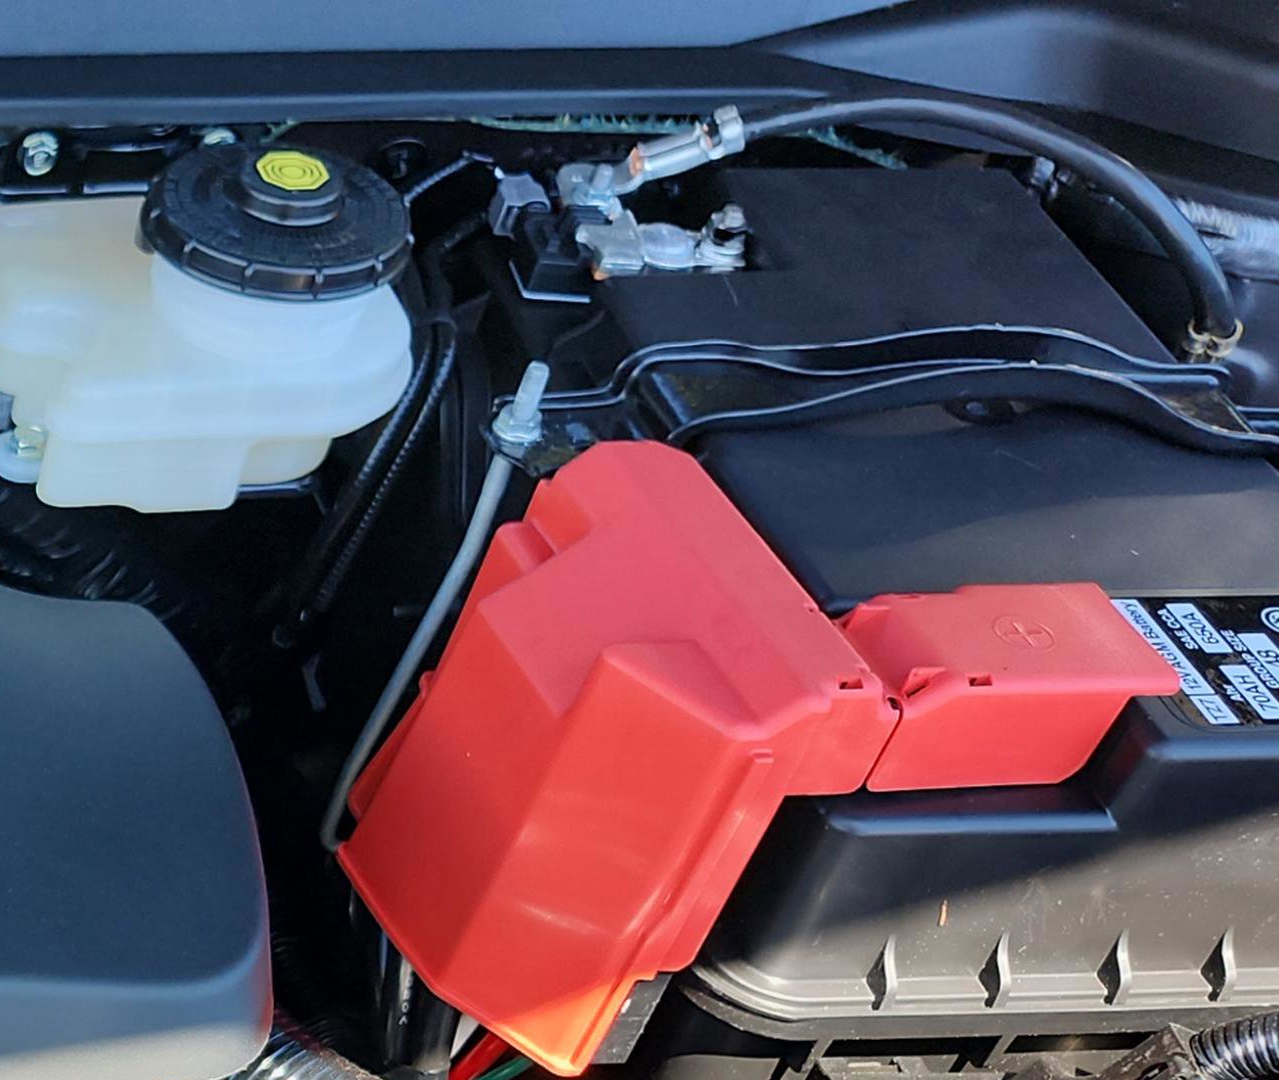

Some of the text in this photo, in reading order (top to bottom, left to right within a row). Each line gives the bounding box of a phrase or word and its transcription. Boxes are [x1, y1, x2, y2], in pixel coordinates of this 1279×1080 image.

[1156, 608, 1199, 650] SAE CCA
[1181, 612, 1220, 645] 650A
[1219, 629, 1279, 688] GROUP SIZE
[1232, 674, 1279, 711] 70AH
